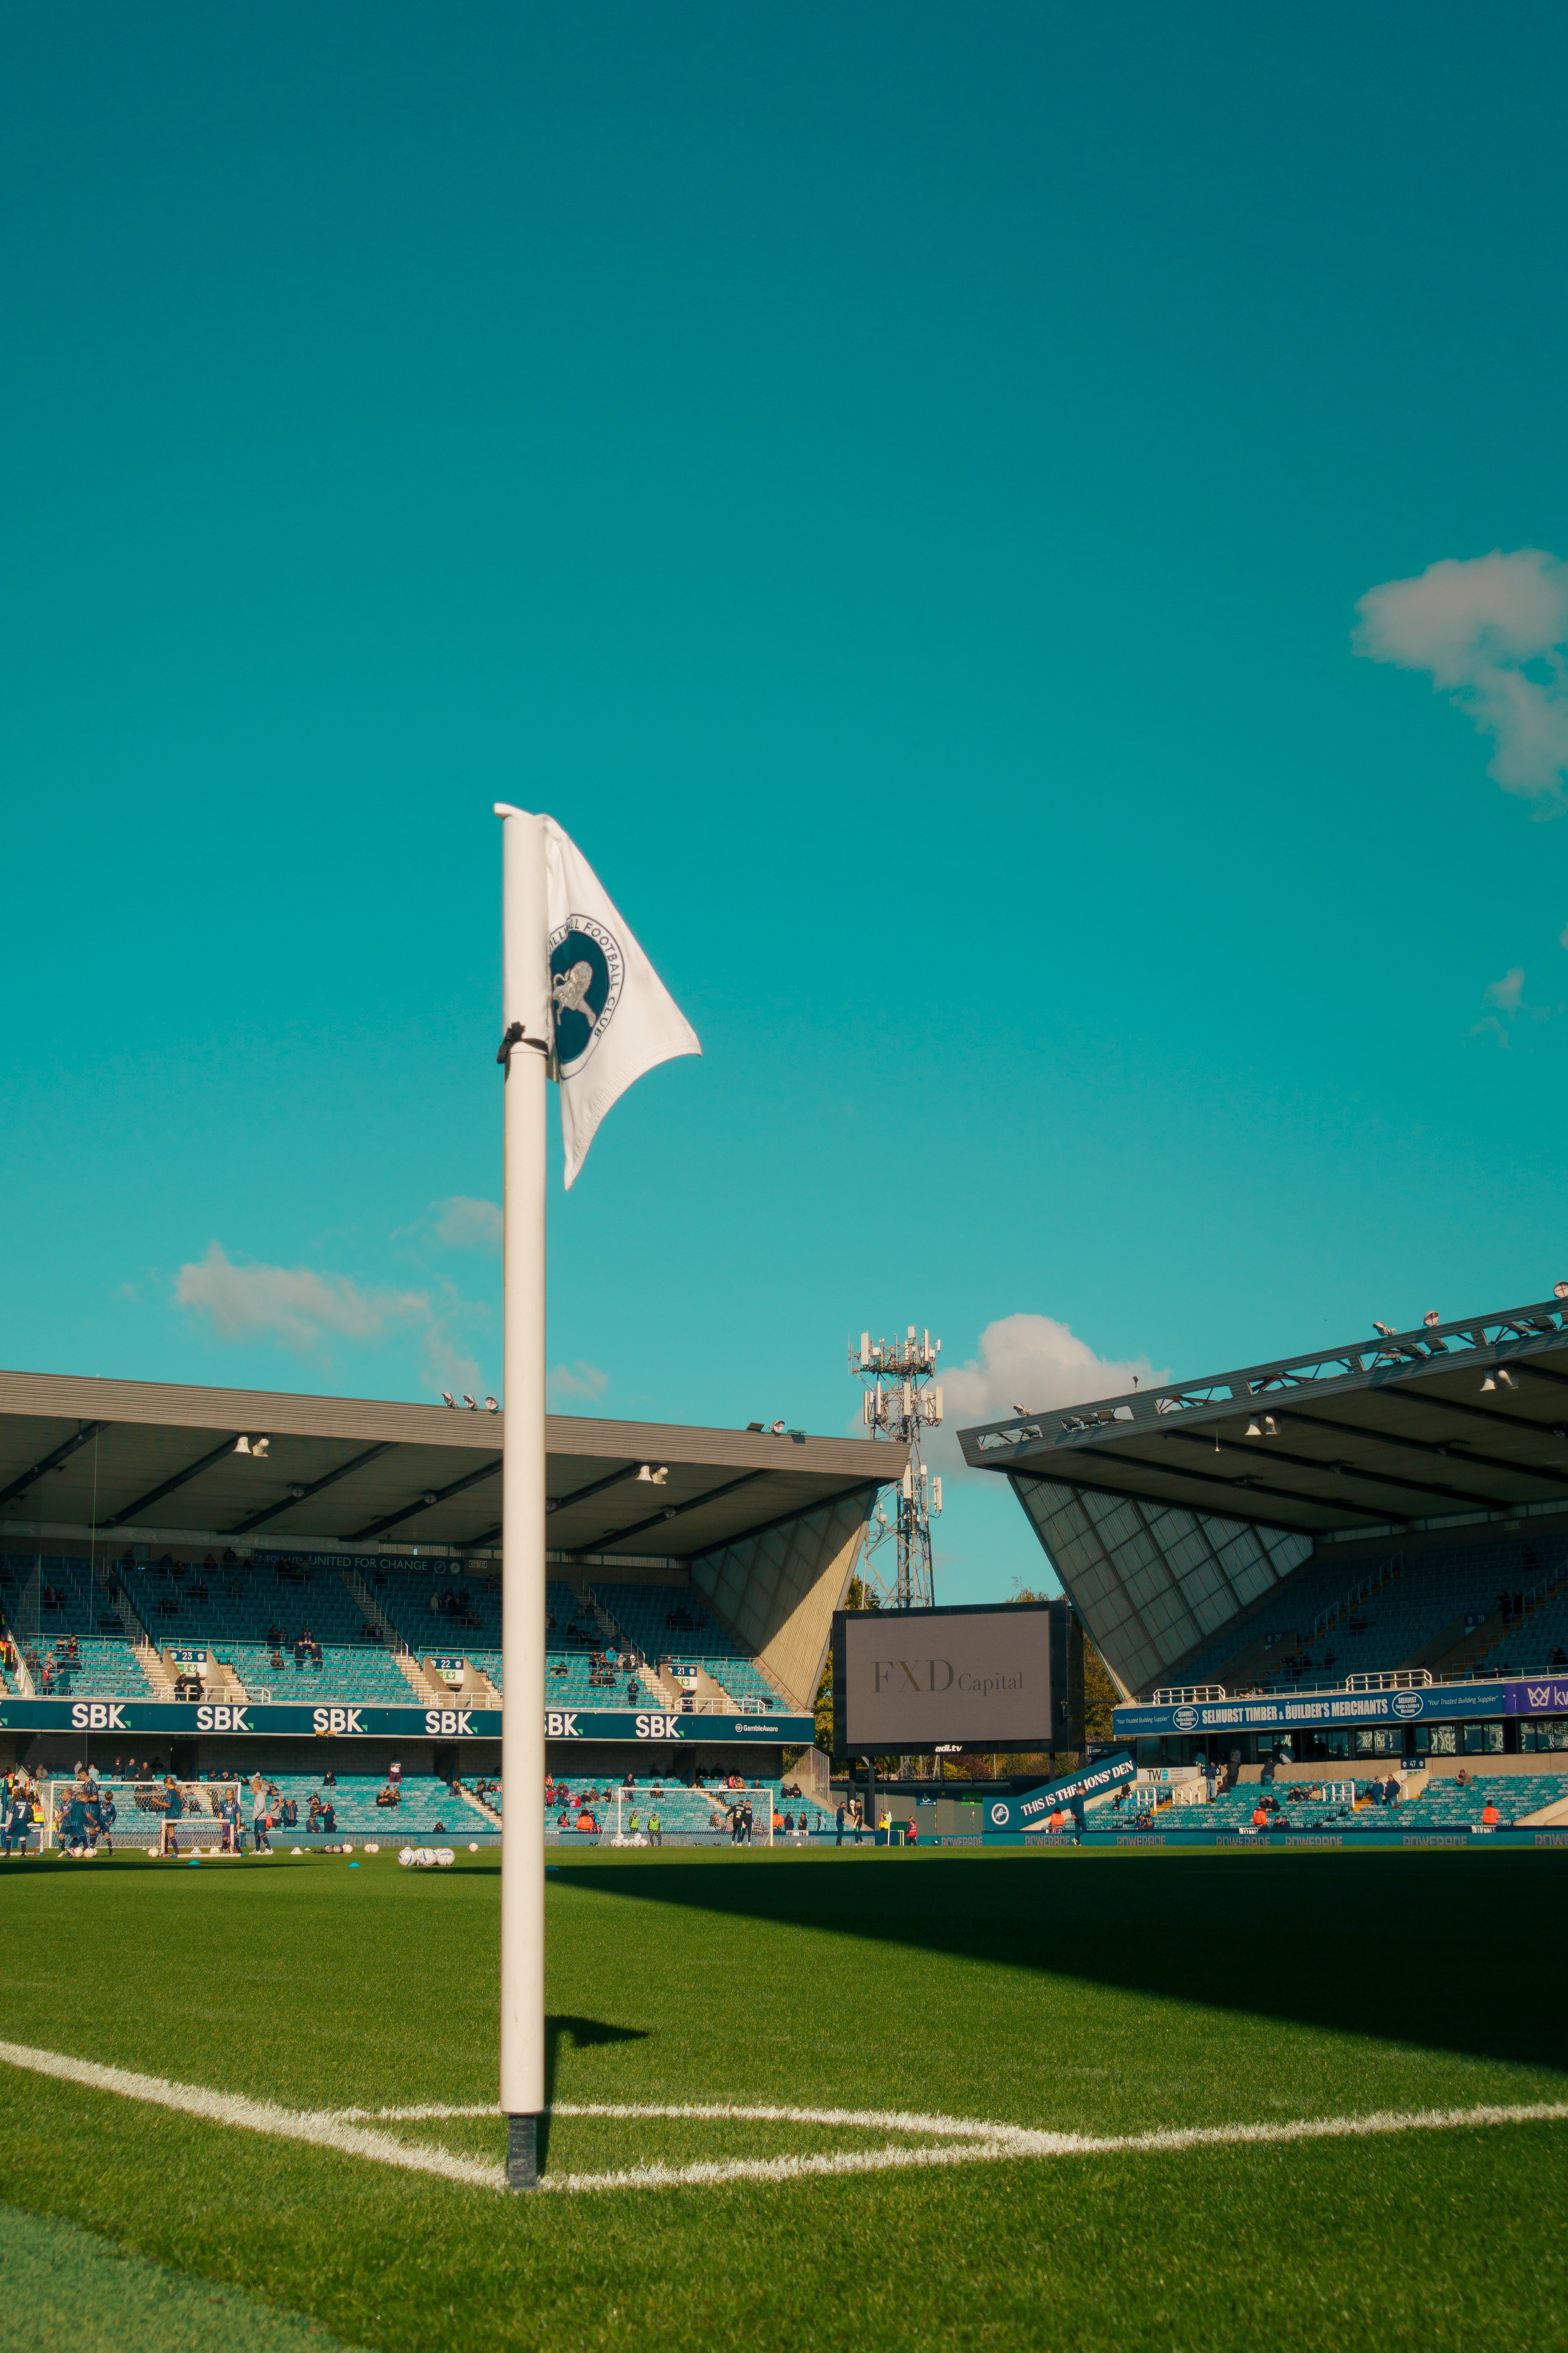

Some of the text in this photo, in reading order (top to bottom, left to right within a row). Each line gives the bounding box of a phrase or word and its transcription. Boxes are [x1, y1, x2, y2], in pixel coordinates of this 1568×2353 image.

[583, 922, 619, 991] FOOTBALL
[594, 996, 615, 1038] CLUB
[309, 1555, 351, 1567] UNITED
[355, 1558, 376, 1568] FOR
[380, 1559, 428, 1570] CHANGE
[1478, 1615, 1484, 1623] 19
[1275, 1634, 1282, 1642] 20
[182, 1652, 192, 1660] 23
[441, 1659, 451, 1668] 22
[871, 1659, 1025, 1697] FXD Capital
[72, 1704, 126, 1728] SBK
[1202, 1698, 1389, 1724] SELHURST TIMBER & BUILDER'S MERCHANTS
[197, 1707, 249, 1730] SBK
[313, 1708, 363, 1731] SBK
[426, 1711, 473, 1734] SBK
[545, 1713, 579, 1736] BK
[636, 1715, 679, 1738] SBK
[1020, 1760, 1134, 1816] THIS IS THE IONS' DEN
[18, 1806, 26, 1819] 7
[344, 1836, 419, 1847] POWERADE
[941, 1836, 982, 1846] POWERADE
[1025, 1835, 1070, 1846] POWERADE
[1116, 1835, 1166, 1845] POWERADE
[1216, 1836, 1270, 1846] POWERADE
[1285, 1836, 1343, 1845] POWERADE
[1403, 1836, 1467, 1845] POWERADE
